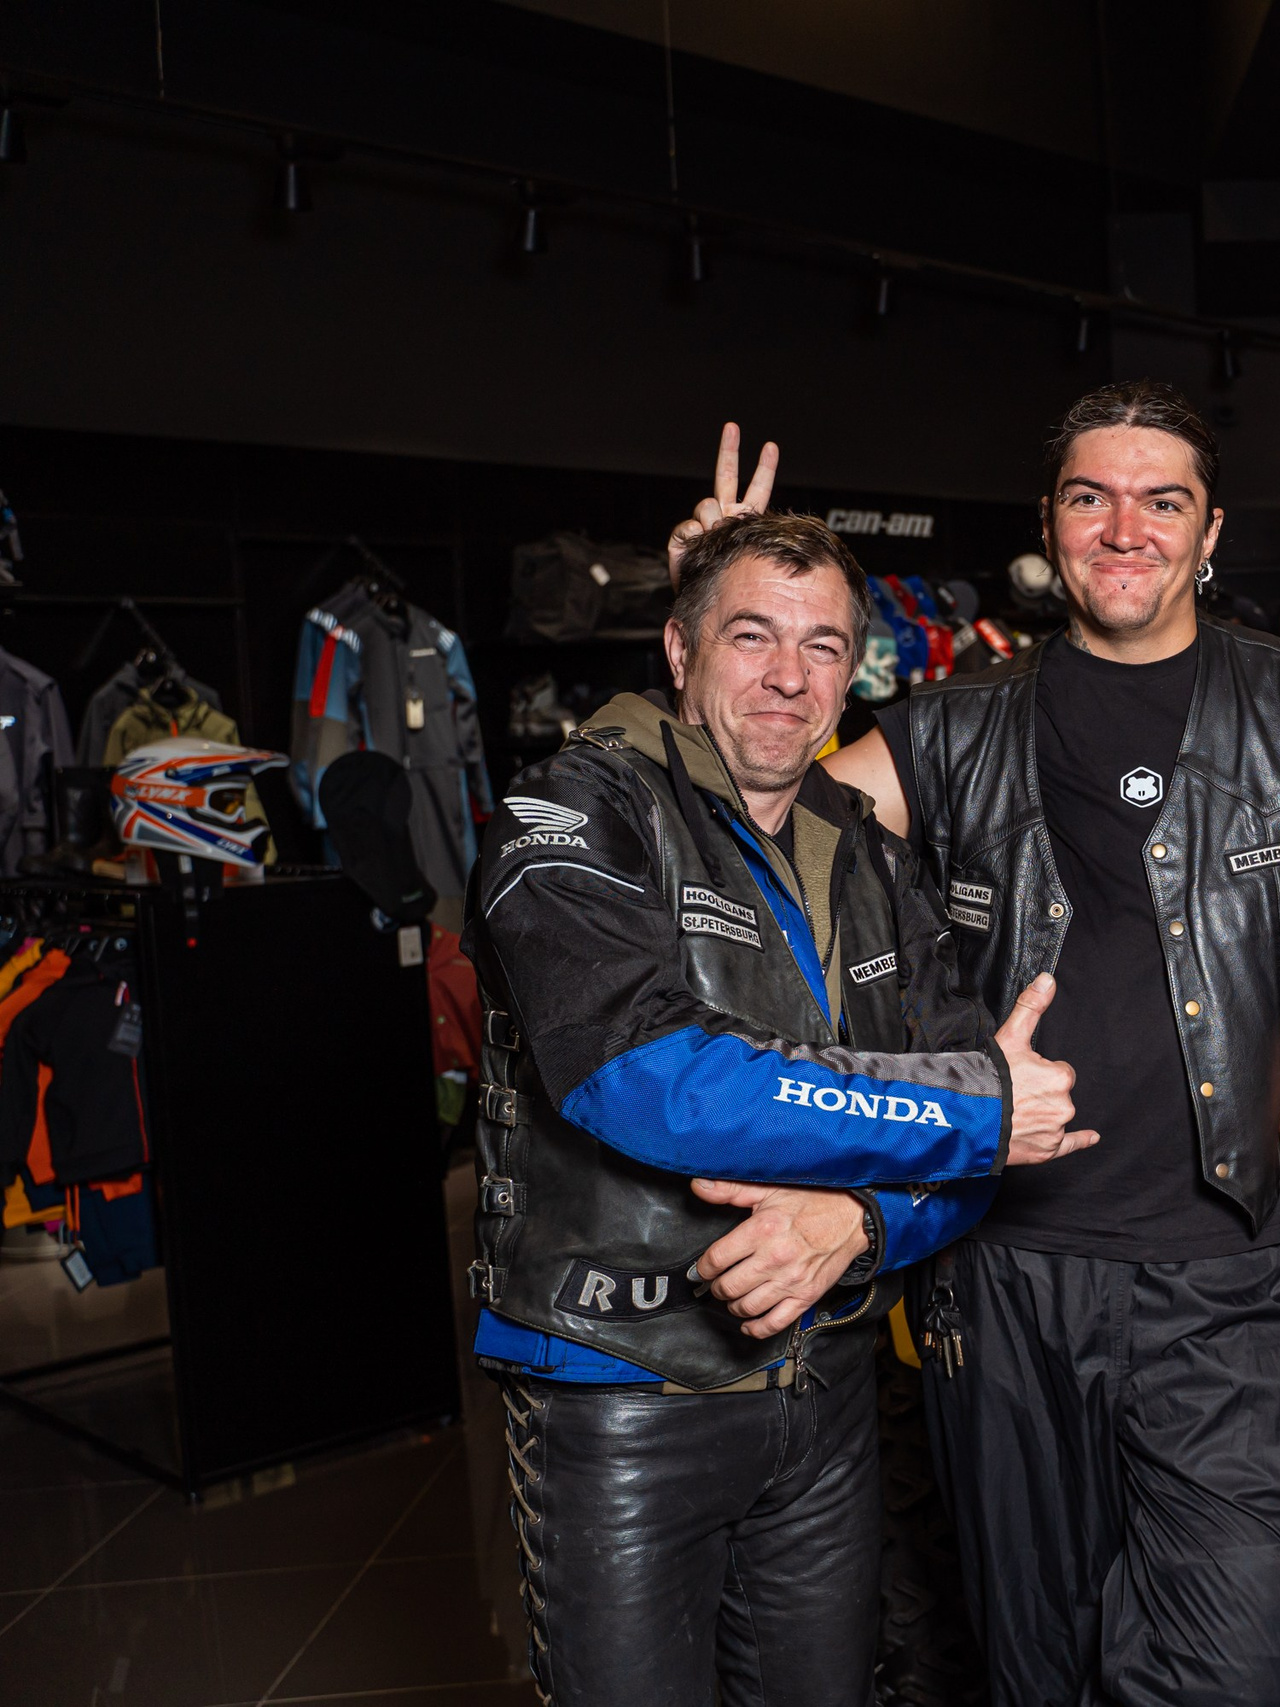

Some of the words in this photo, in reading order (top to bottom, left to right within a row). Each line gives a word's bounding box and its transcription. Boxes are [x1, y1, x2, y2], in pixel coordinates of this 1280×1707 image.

[827, 509, 933, 538] can-am
[138, 784, 193, 801] LYNX
[501, 833, 590, 858] HONDA
[686, 890, 754, 920] HOOLIGANS
[853, 956, 896, 981] MEMBE
[773, 1077, 952, 1128] HONDA
